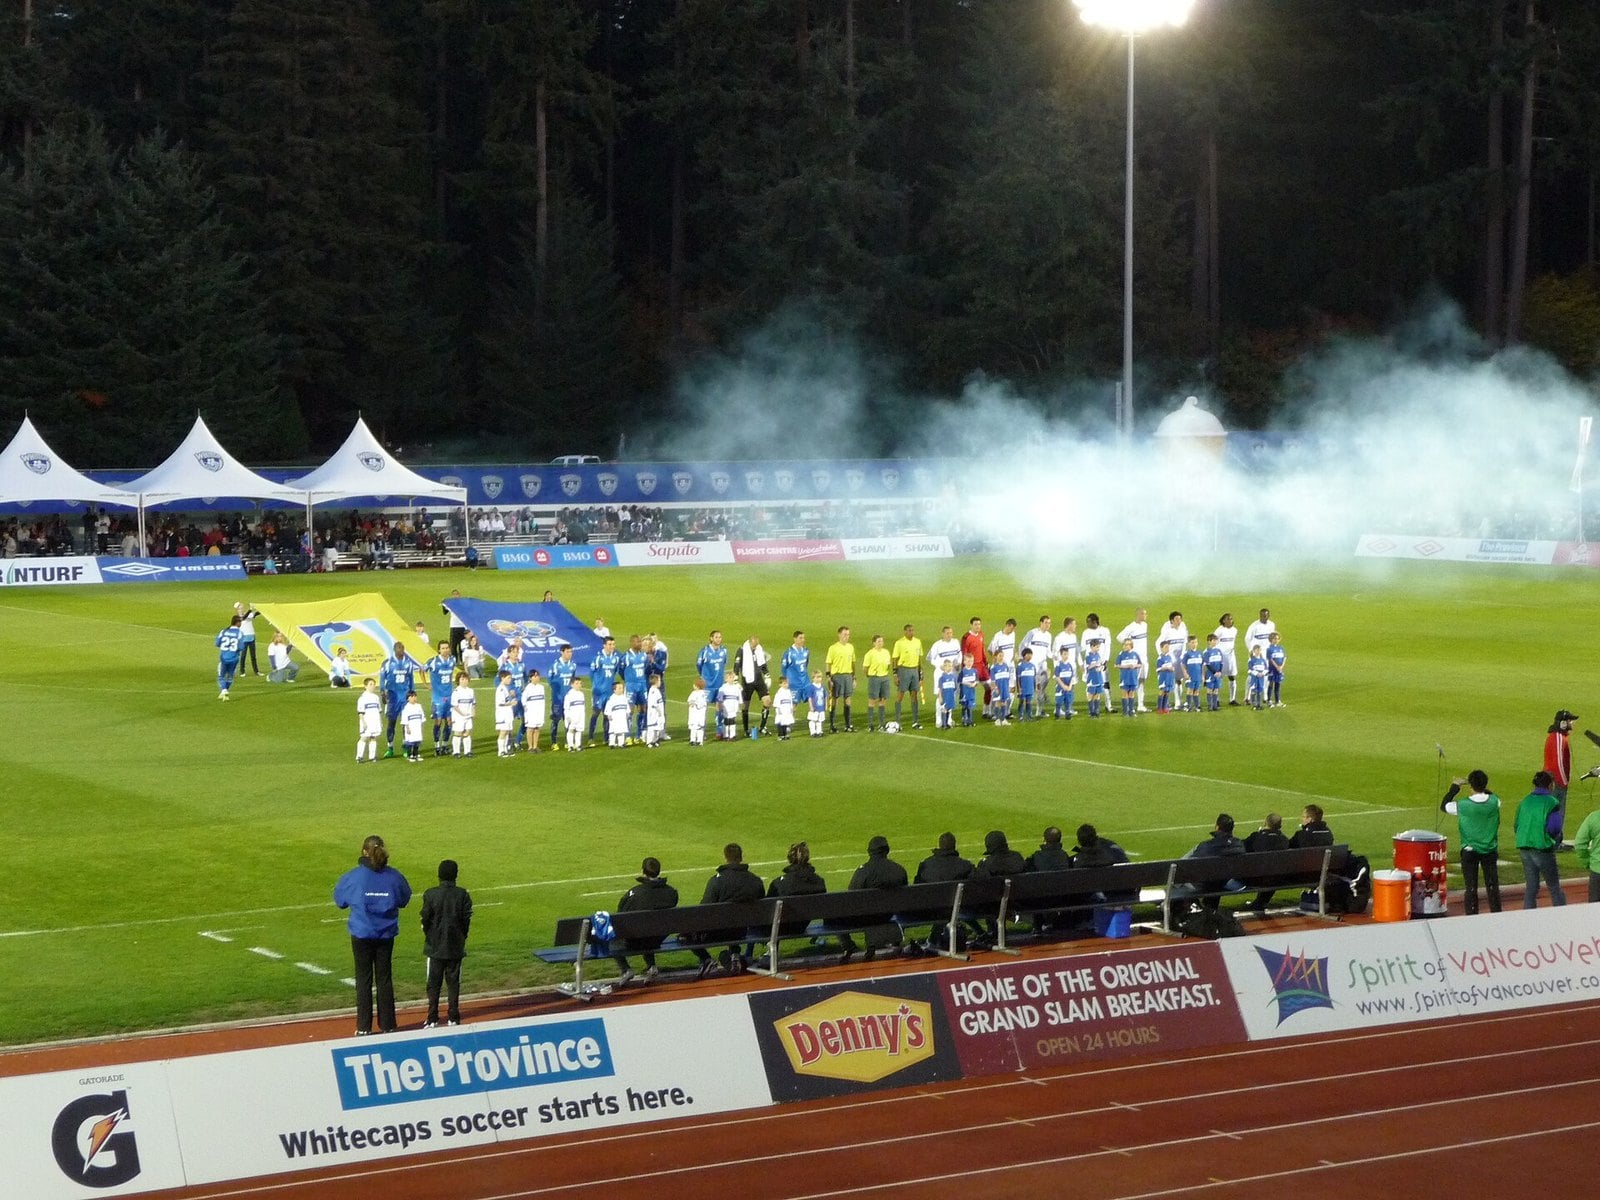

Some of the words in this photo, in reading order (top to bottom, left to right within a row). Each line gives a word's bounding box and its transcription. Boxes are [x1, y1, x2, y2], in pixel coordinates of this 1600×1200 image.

[563, 551, 590, 561] BMO
[647, 543, 701, 560] Saputo
[737, 547, 765, 556] FLIGHT
[766, 546, 798, 555] CENTRE
[851, 545, 886, 553] SHAW
[905, 543, 940, 552] SHAW
[502, 553, 529, 563] BMO
[220, 636, 238, 651] 23
[563, 678, 571, 686] 17
[950, 976, 1018, 1007] HOME
[1022, 973, 1051, 999] OF
[1055, 968, 1096, 995] THE
[1100, 957, 1200, 989] ORIGINAL
[1348, 954, 1422, 993] Spirit
[1423, 957, 1447, 983] of
[959, 1004, 1040, 1036] GRAND
[1044, 996, 1104, 1026] SLAM
[1107, 984, 1221, 1018] BREAKFAST.
[787, 1003, 925, 1066] Denny's
[1036, 1036, 1080, 1057] OPEN
[1083, 1033, 1104, 1051] 24
[1106, 1026, 1160, 1047] HOURS
[344, 1053, 425, 1098] The
[427, 1035, 602, 1089] Province
[79, 1073, 125, 1086] GATORADE
[279, 1119, 432, 1159] Whitecaps
[441, 1104, 528, 1137] soccer
[539, 1091, 620, 1123] starts
[626, 1084, 694, 1112] here.
[51, 1089, 141, 1188] G
